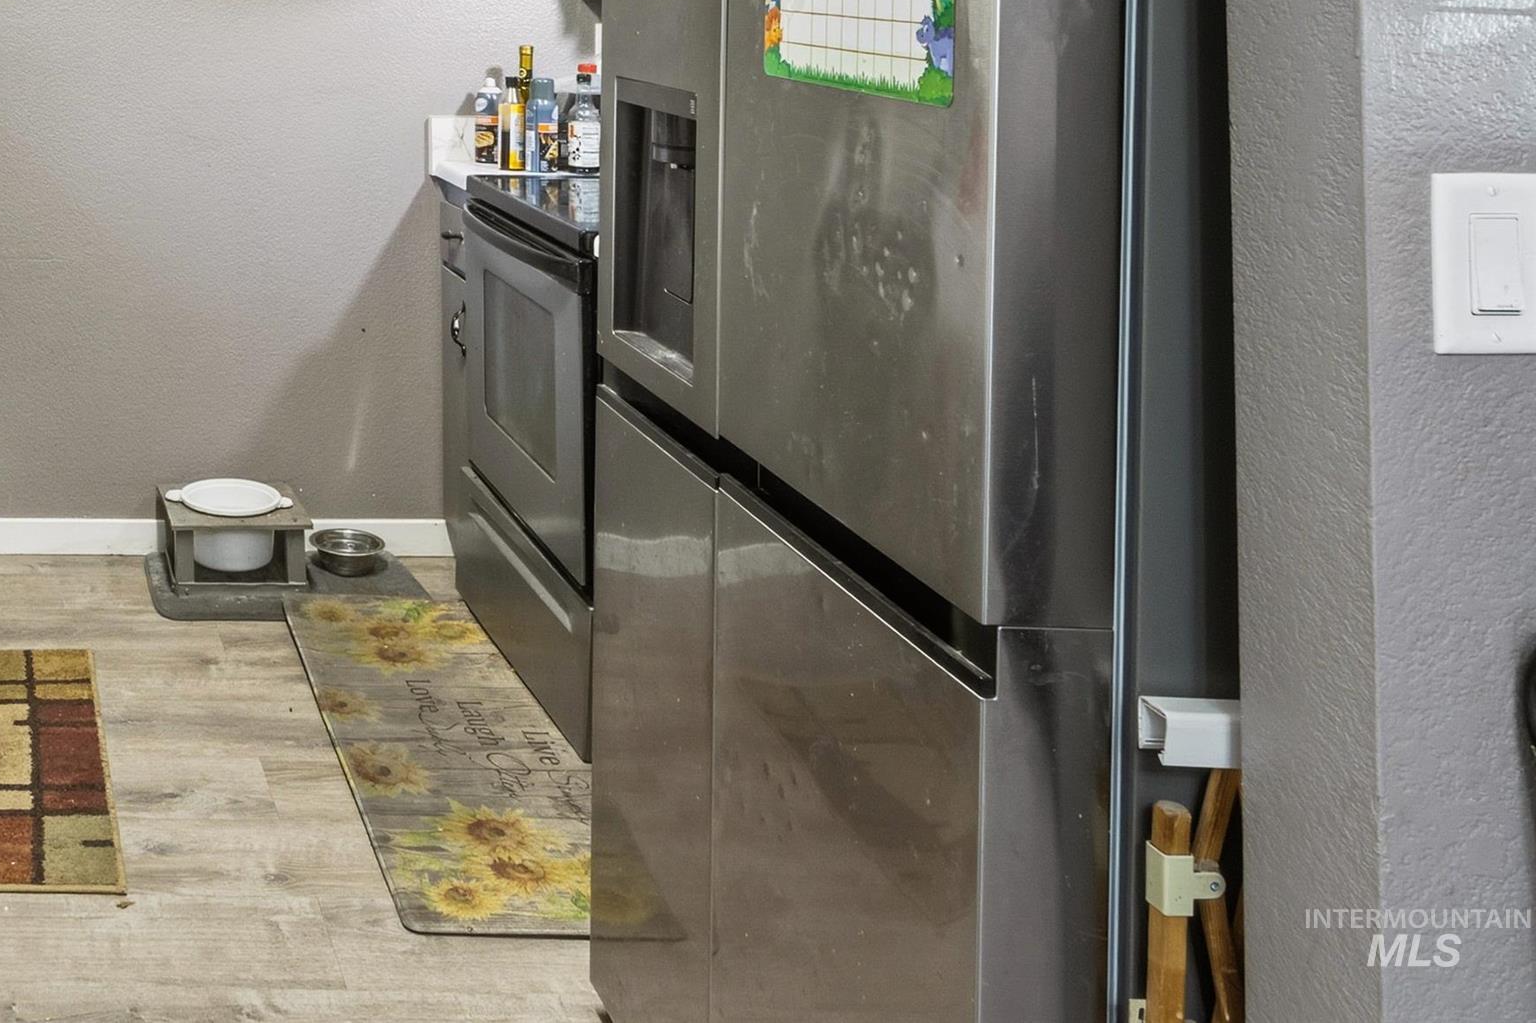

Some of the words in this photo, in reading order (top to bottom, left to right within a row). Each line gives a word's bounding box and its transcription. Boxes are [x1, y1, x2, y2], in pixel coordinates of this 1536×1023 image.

[405, 680, 440, 714] Love
[456, 700, 506, 747] Laugh
[521, 729, 561, 766] Live
